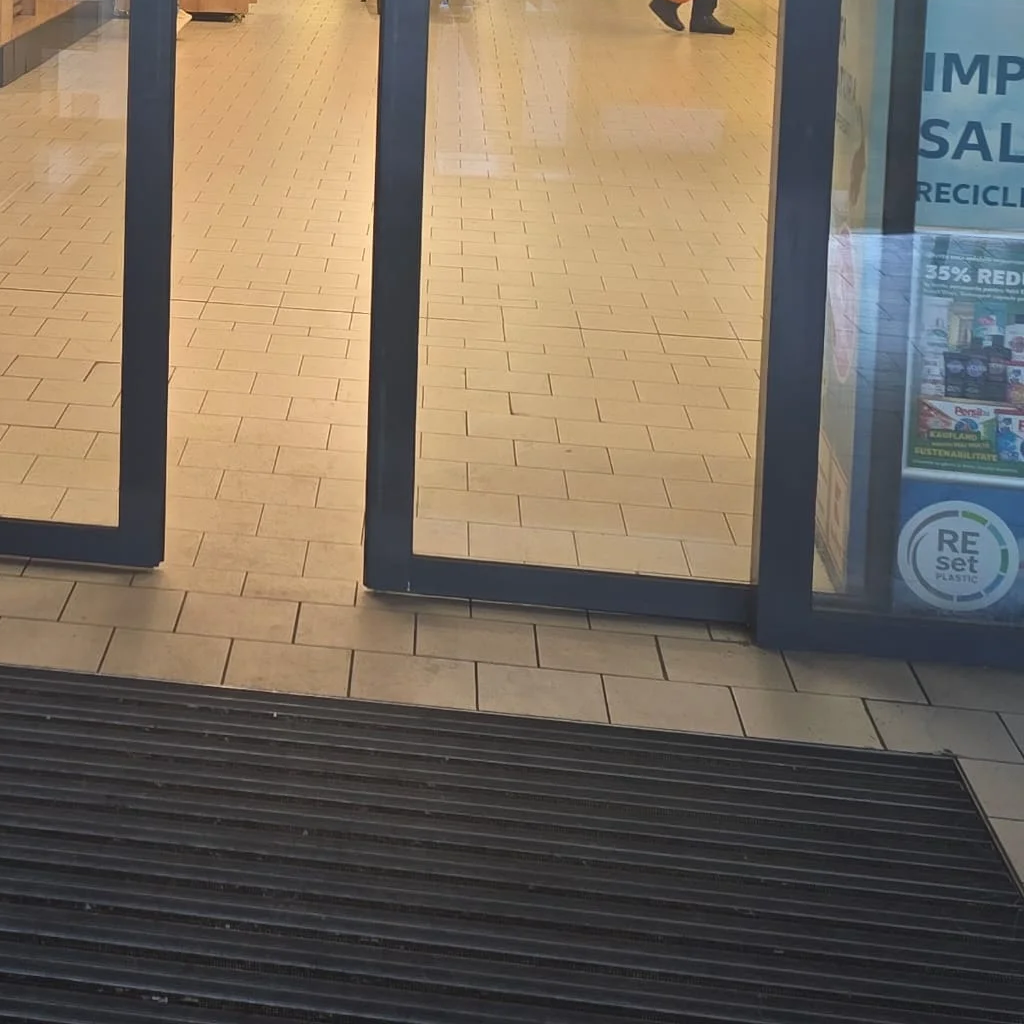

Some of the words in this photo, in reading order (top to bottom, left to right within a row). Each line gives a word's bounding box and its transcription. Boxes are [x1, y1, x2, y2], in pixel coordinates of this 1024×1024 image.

[922, 52, 1024, 96] IMP
[918, 118, 1024, 164] SAL
[925, 264, 972, 284] 35%
[977, 268, 1024, 286] RED
[938, 529, 980, 555] RE
[936, 556, 978, 574] set
[936, 573, 978, 584] PLASTIC
